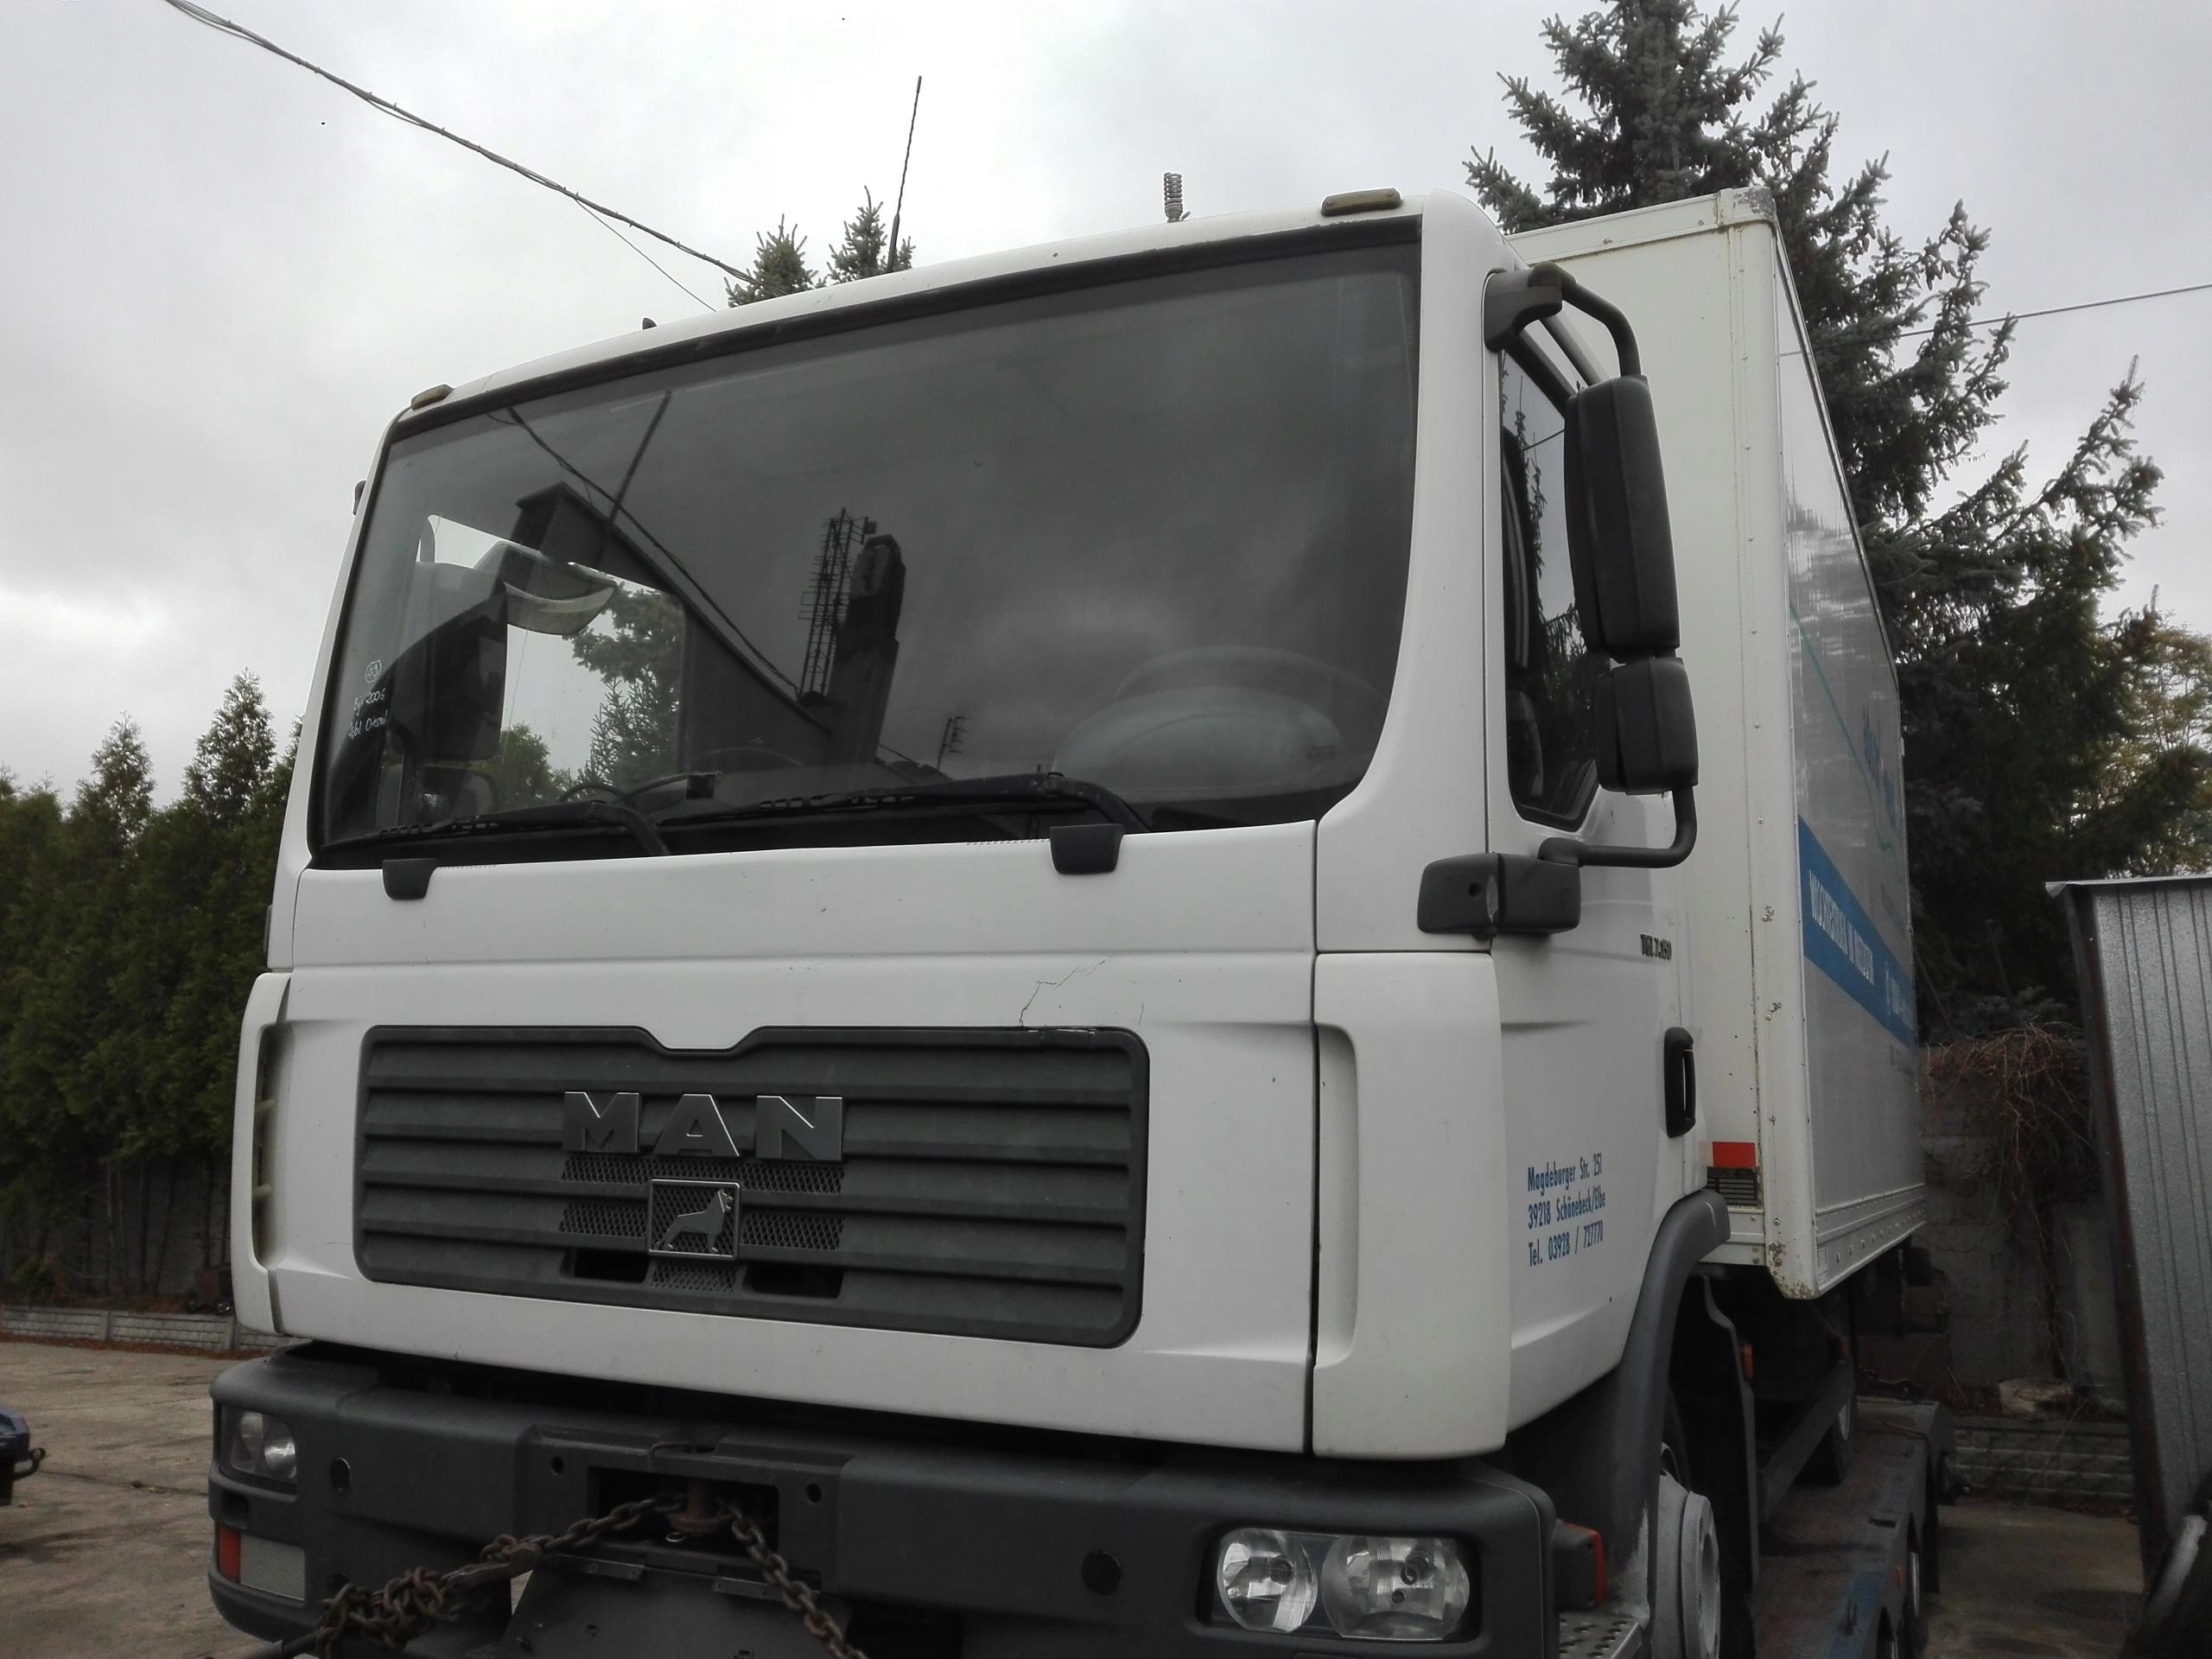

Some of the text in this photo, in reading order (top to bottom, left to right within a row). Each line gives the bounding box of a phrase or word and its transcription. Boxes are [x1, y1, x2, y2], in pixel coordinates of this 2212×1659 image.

[365, 688, 385, 703] 2006
[563, 1091, 843, 1162] MAN
[1527, 1160, 1576, 1197] Magdeburger
[1580, 1156, 1590, 1180] Str.
[1528, 1200, 1552, 1230] 39218
[1529, 1238, 1542, 1267] Tel.
[1548, 1231, 1570, 1261] 03928
